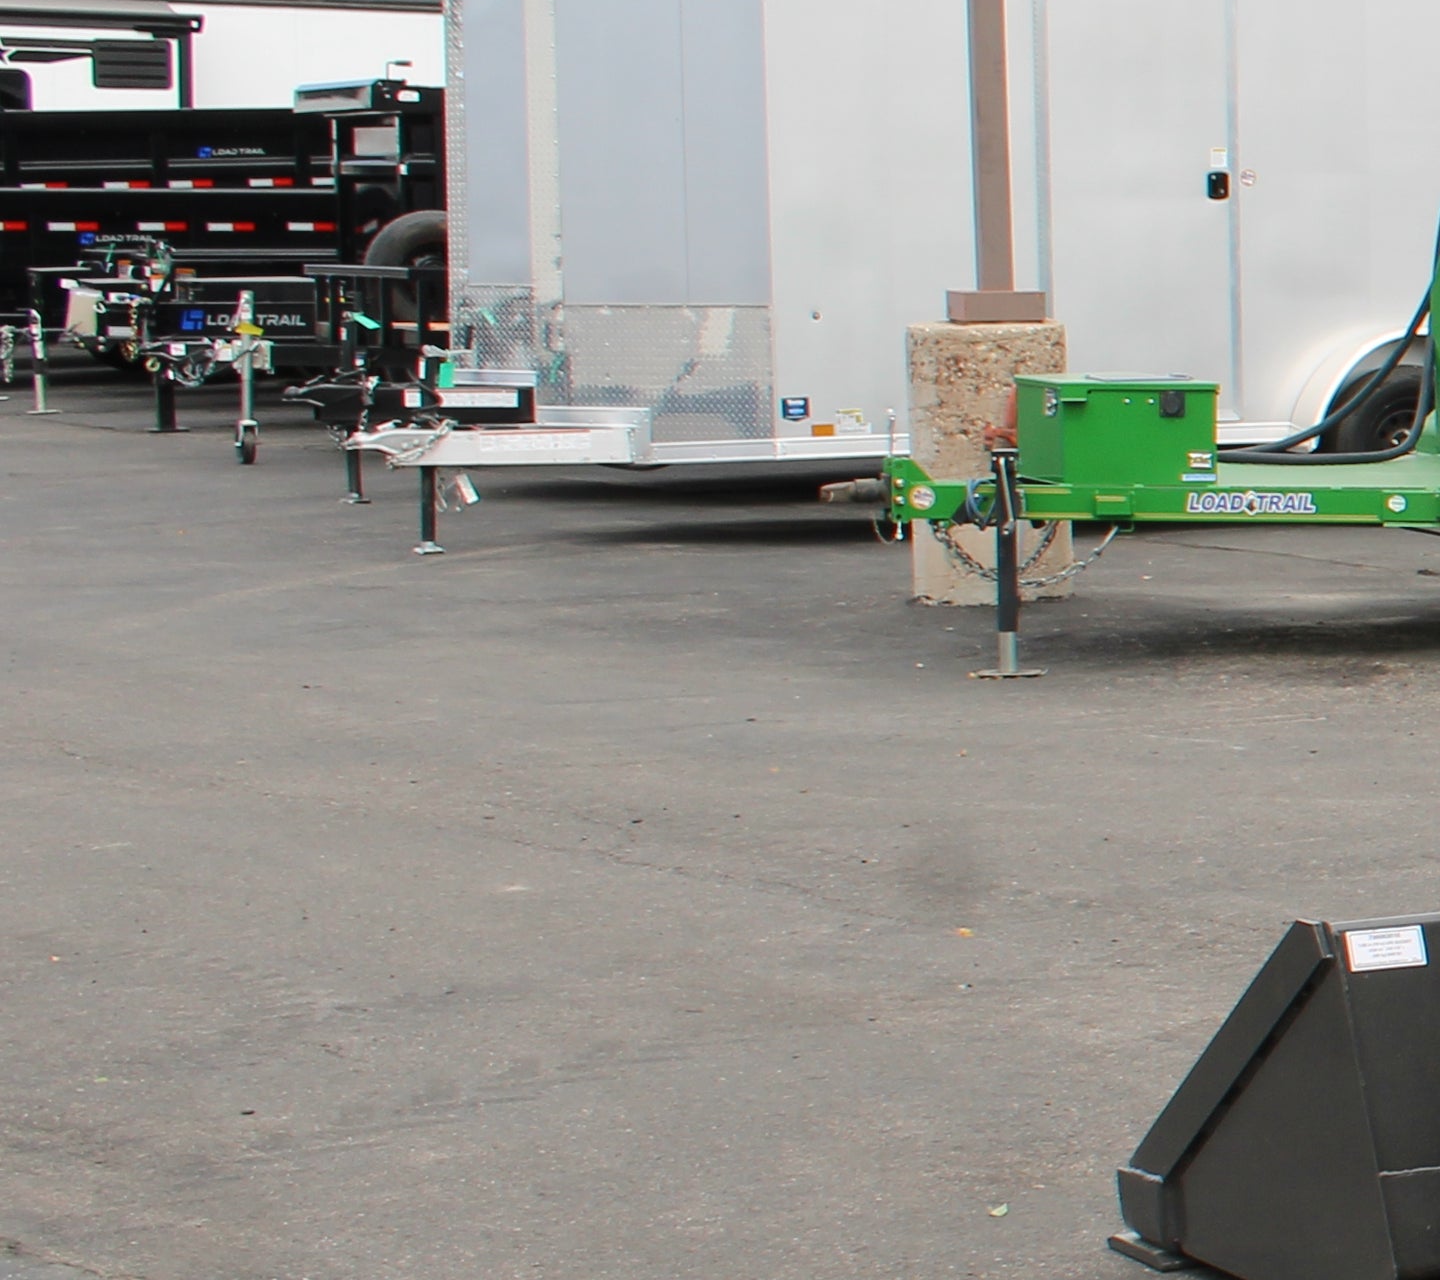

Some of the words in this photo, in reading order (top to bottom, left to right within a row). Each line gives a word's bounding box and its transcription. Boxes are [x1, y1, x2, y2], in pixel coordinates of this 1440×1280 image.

[238, 147, 265, 155] TRAIL
[257, 314, 307, 326] TRAIL
[1187, 492, 1245, 514] LOAD
[1255, 492, 1317, 515] TRAIL
